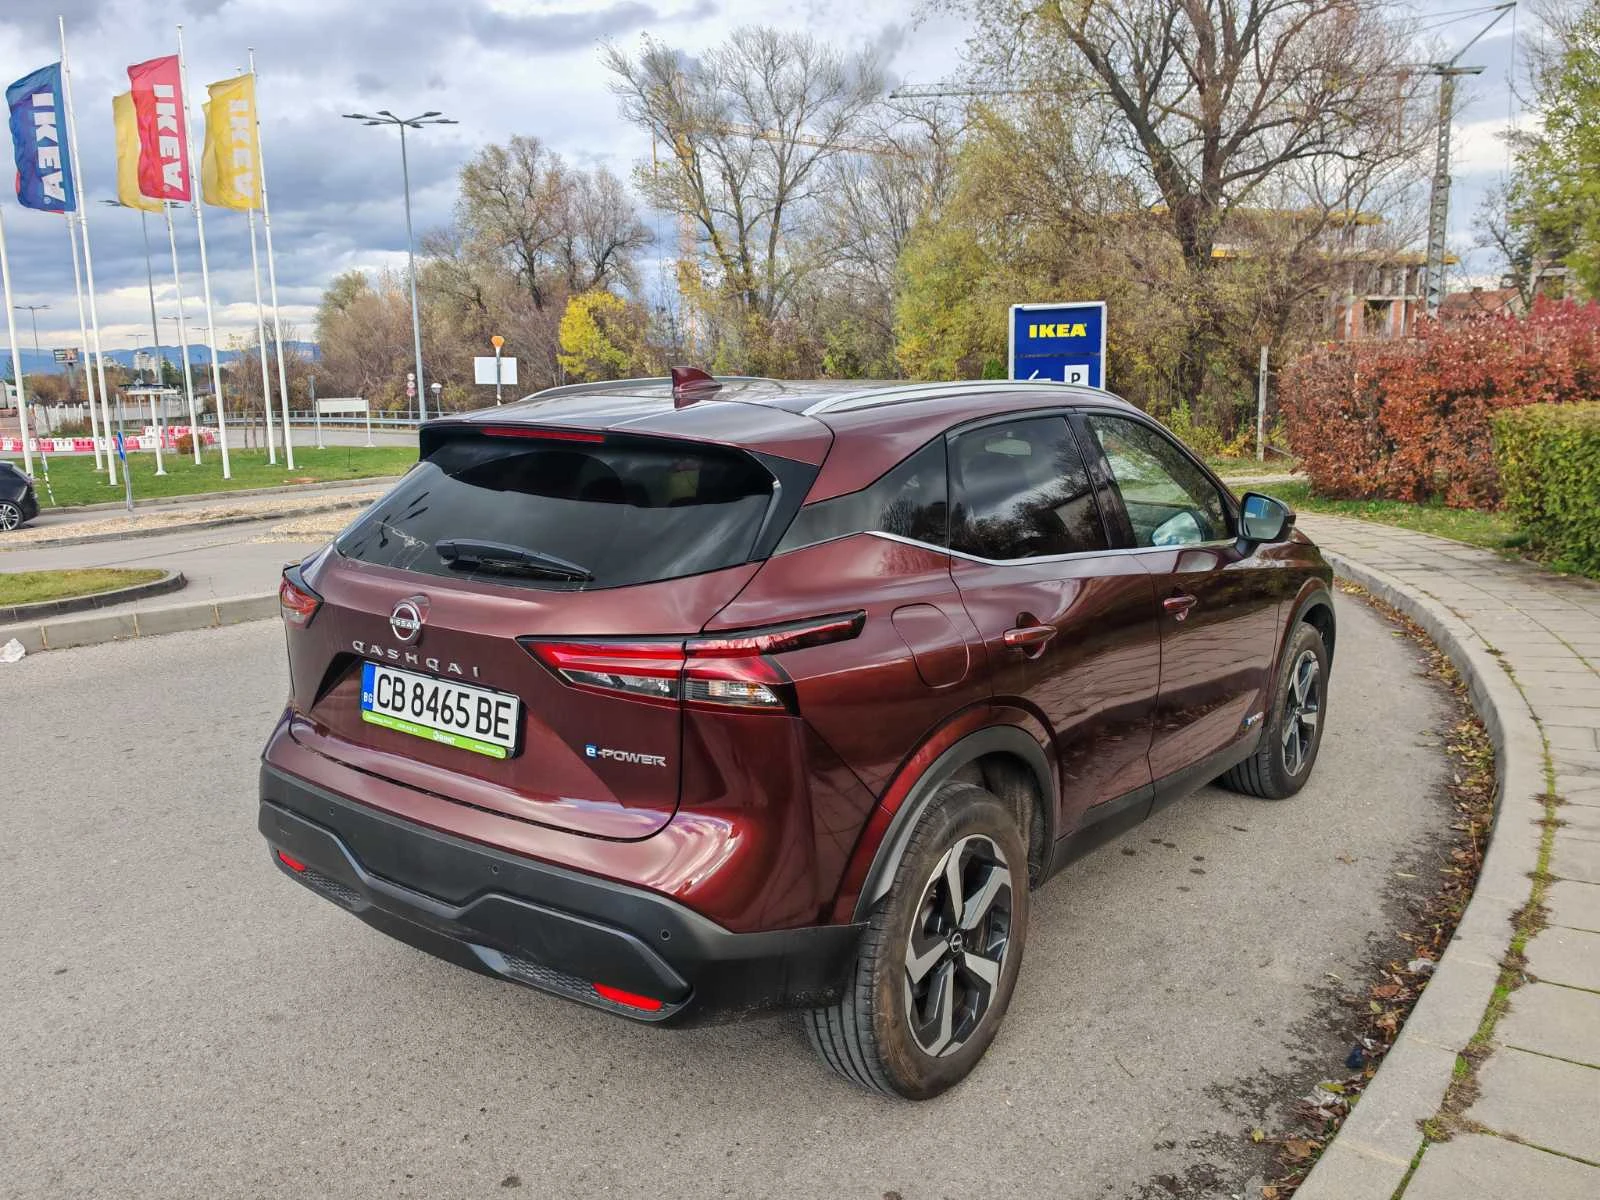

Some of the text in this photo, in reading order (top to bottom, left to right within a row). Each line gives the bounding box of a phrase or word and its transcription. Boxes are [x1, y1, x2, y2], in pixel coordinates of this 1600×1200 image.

[32, 93, 66, 202] IKEA
[153, 84, 184, 192] IKEA
[228, 99, 254, 200] IKEA
[1029, 323, 1087, 338] IKEA
[1071, 372, 1081, 383] P
[390, 617, 420, 630] NISSAN
[352, 640, 480, 678] QASHQAI
[363, 691, 374, 704] BG
[377, 674, 511, 740] CB 8465 BE
[585, 744, 666, 767] e-POWER
